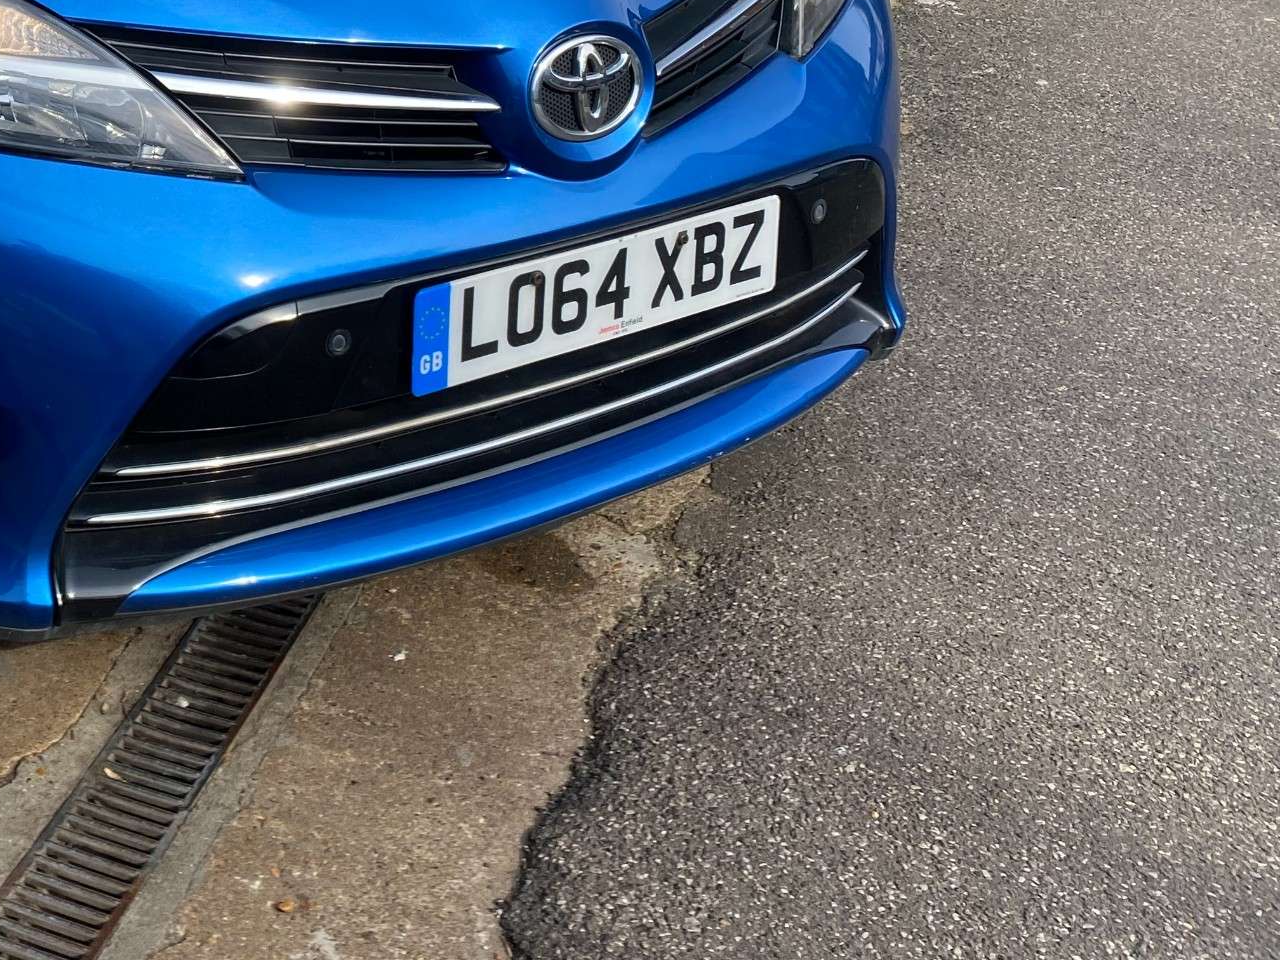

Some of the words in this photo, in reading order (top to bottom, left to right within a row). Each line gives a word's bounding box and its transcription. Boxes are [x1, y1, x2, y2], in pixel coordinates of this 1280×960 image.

[460, 247, 630, 363] LO64
[651, 209, 766, 309] XBZ
[419, 351, 444, 375] GB
